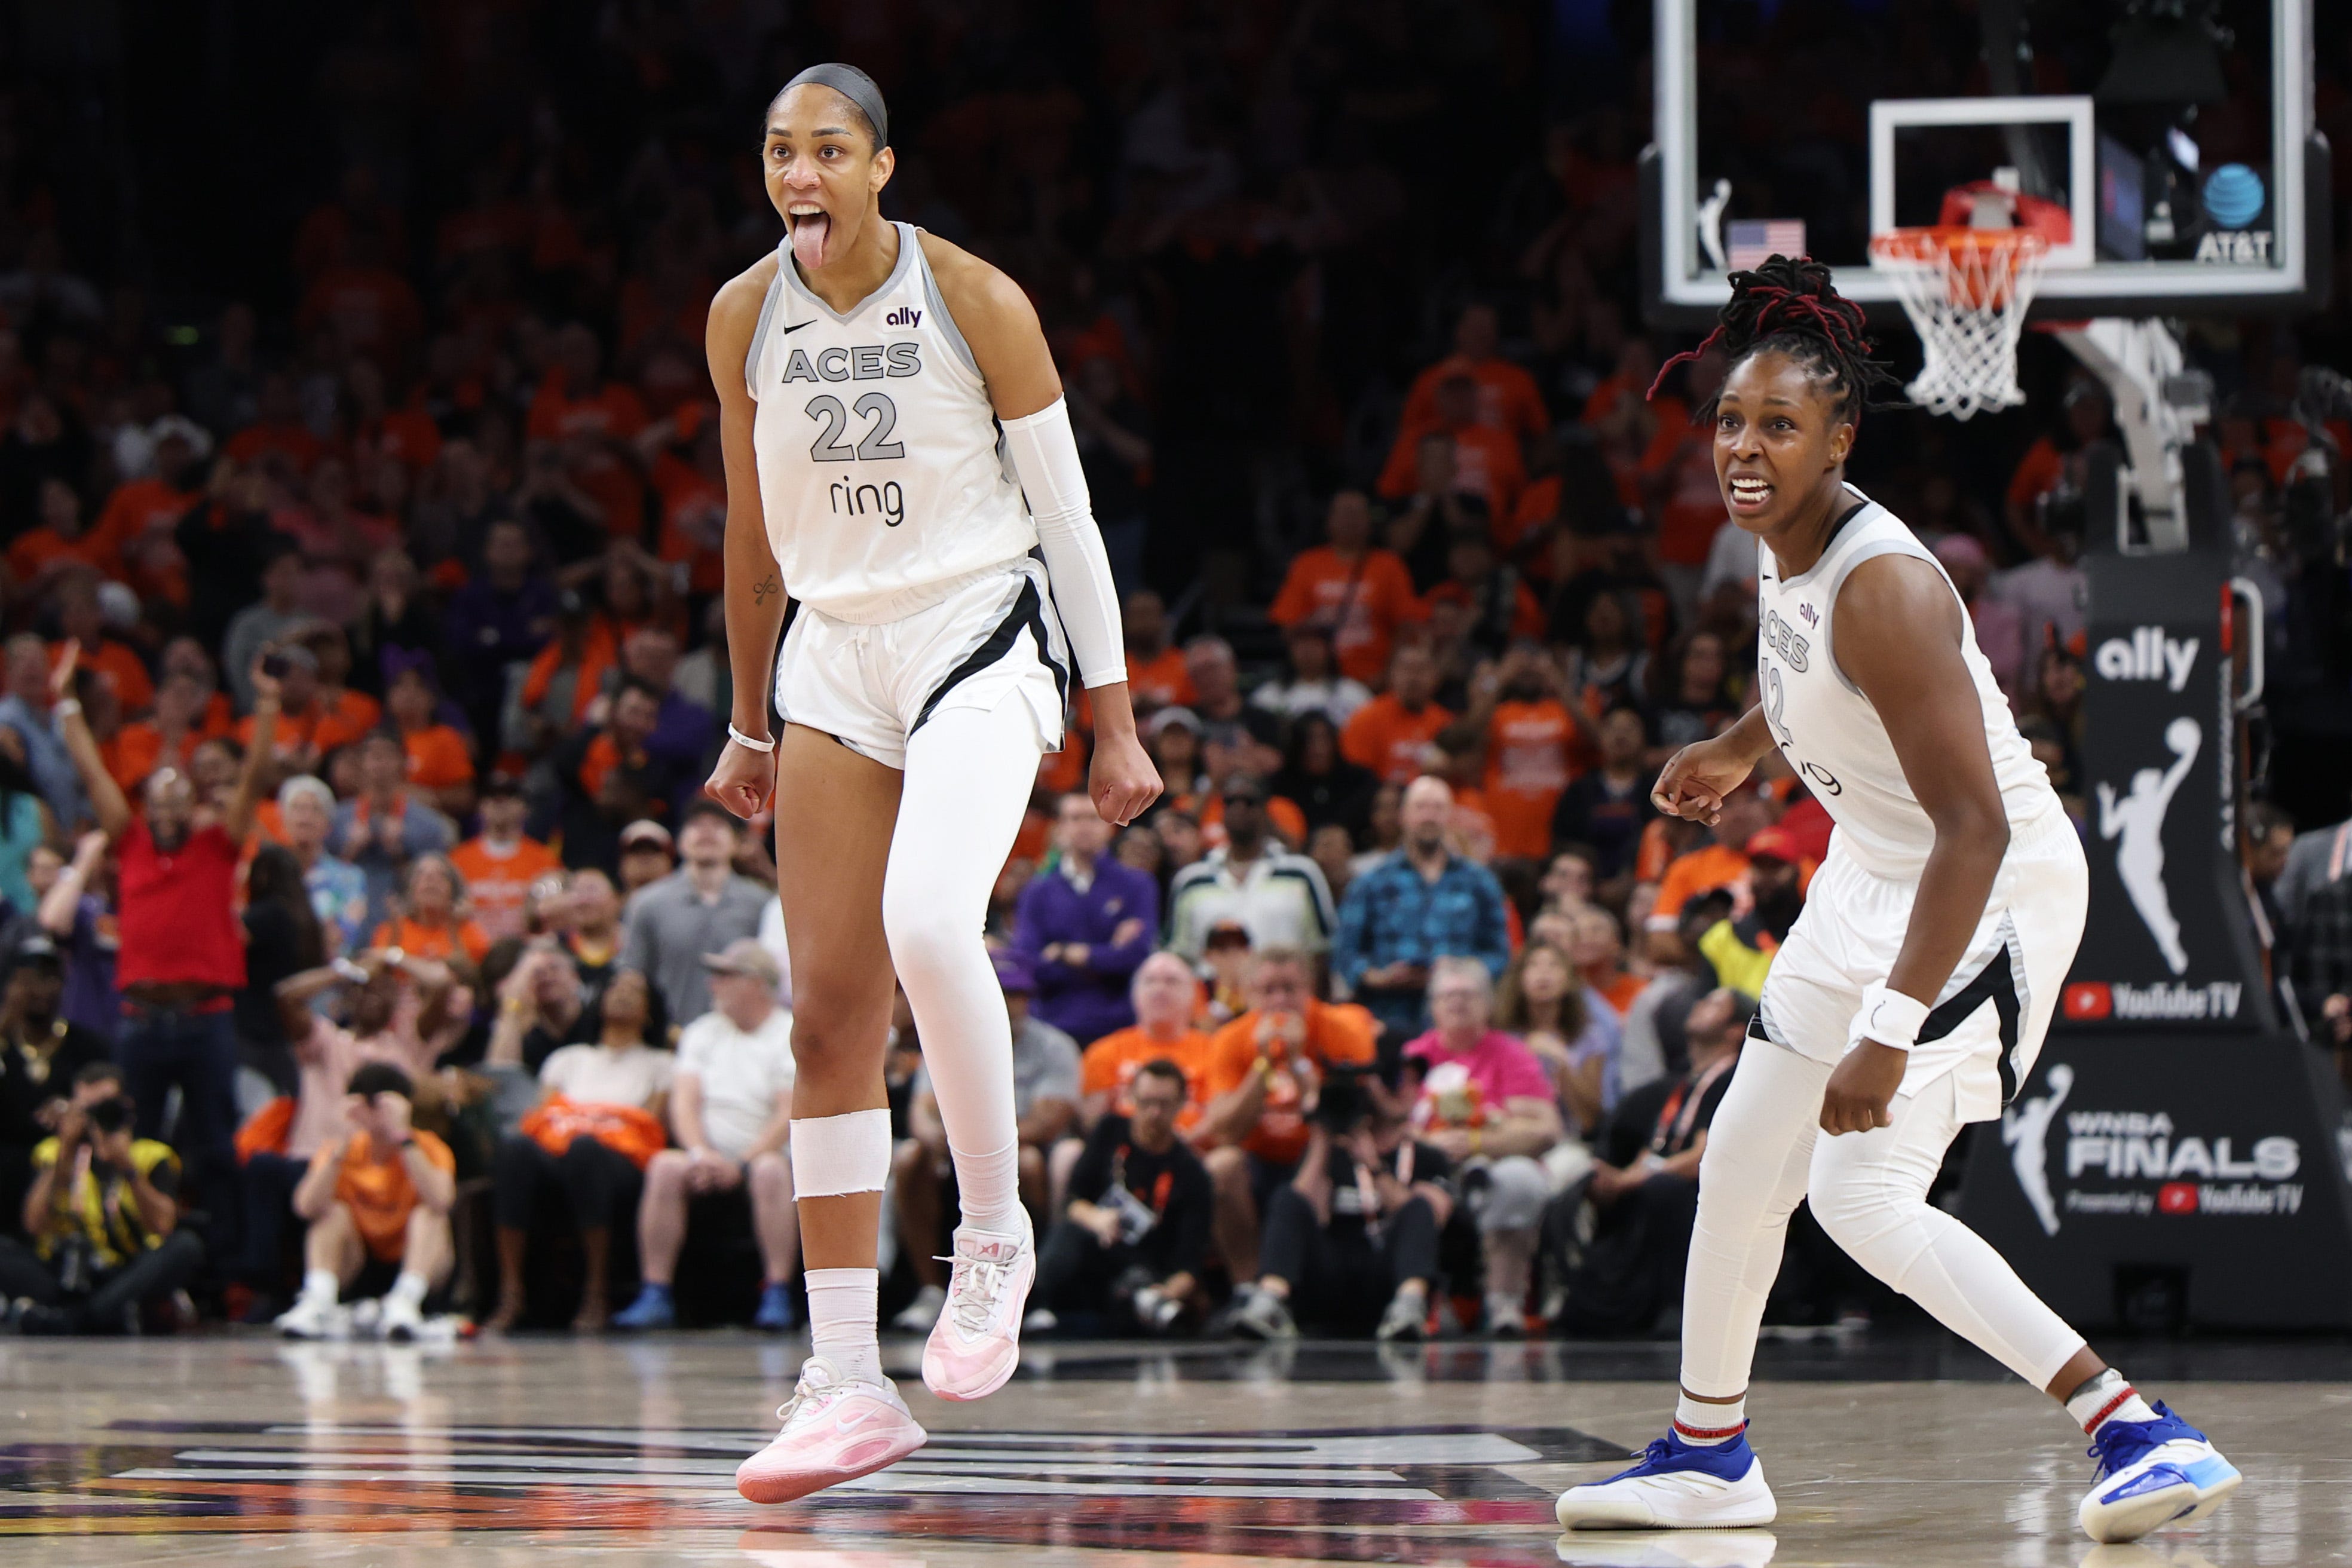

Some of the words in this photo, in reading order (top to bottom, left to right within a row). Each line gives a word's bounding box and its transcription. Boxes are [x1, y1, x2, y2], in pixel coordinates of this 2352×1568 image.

[2194, 231, 2271, 264] AT&T
[887, 307, 922, 328] ally
[782, 342, 921, 383] ACES
[804, 392, 905, 462] 22
[830, 476, 904, 527] ring
[1800, 602, 1820, 630] ally
[2095, 626, 2200, 692] ally
[2111, 982, 2208, 1018] YouTube
[2209, 981, 2242, 1018] TV
[2066, 1111, 2175, 1136] WNBA
[2066, 1136, 2300, 1180] FINALS
